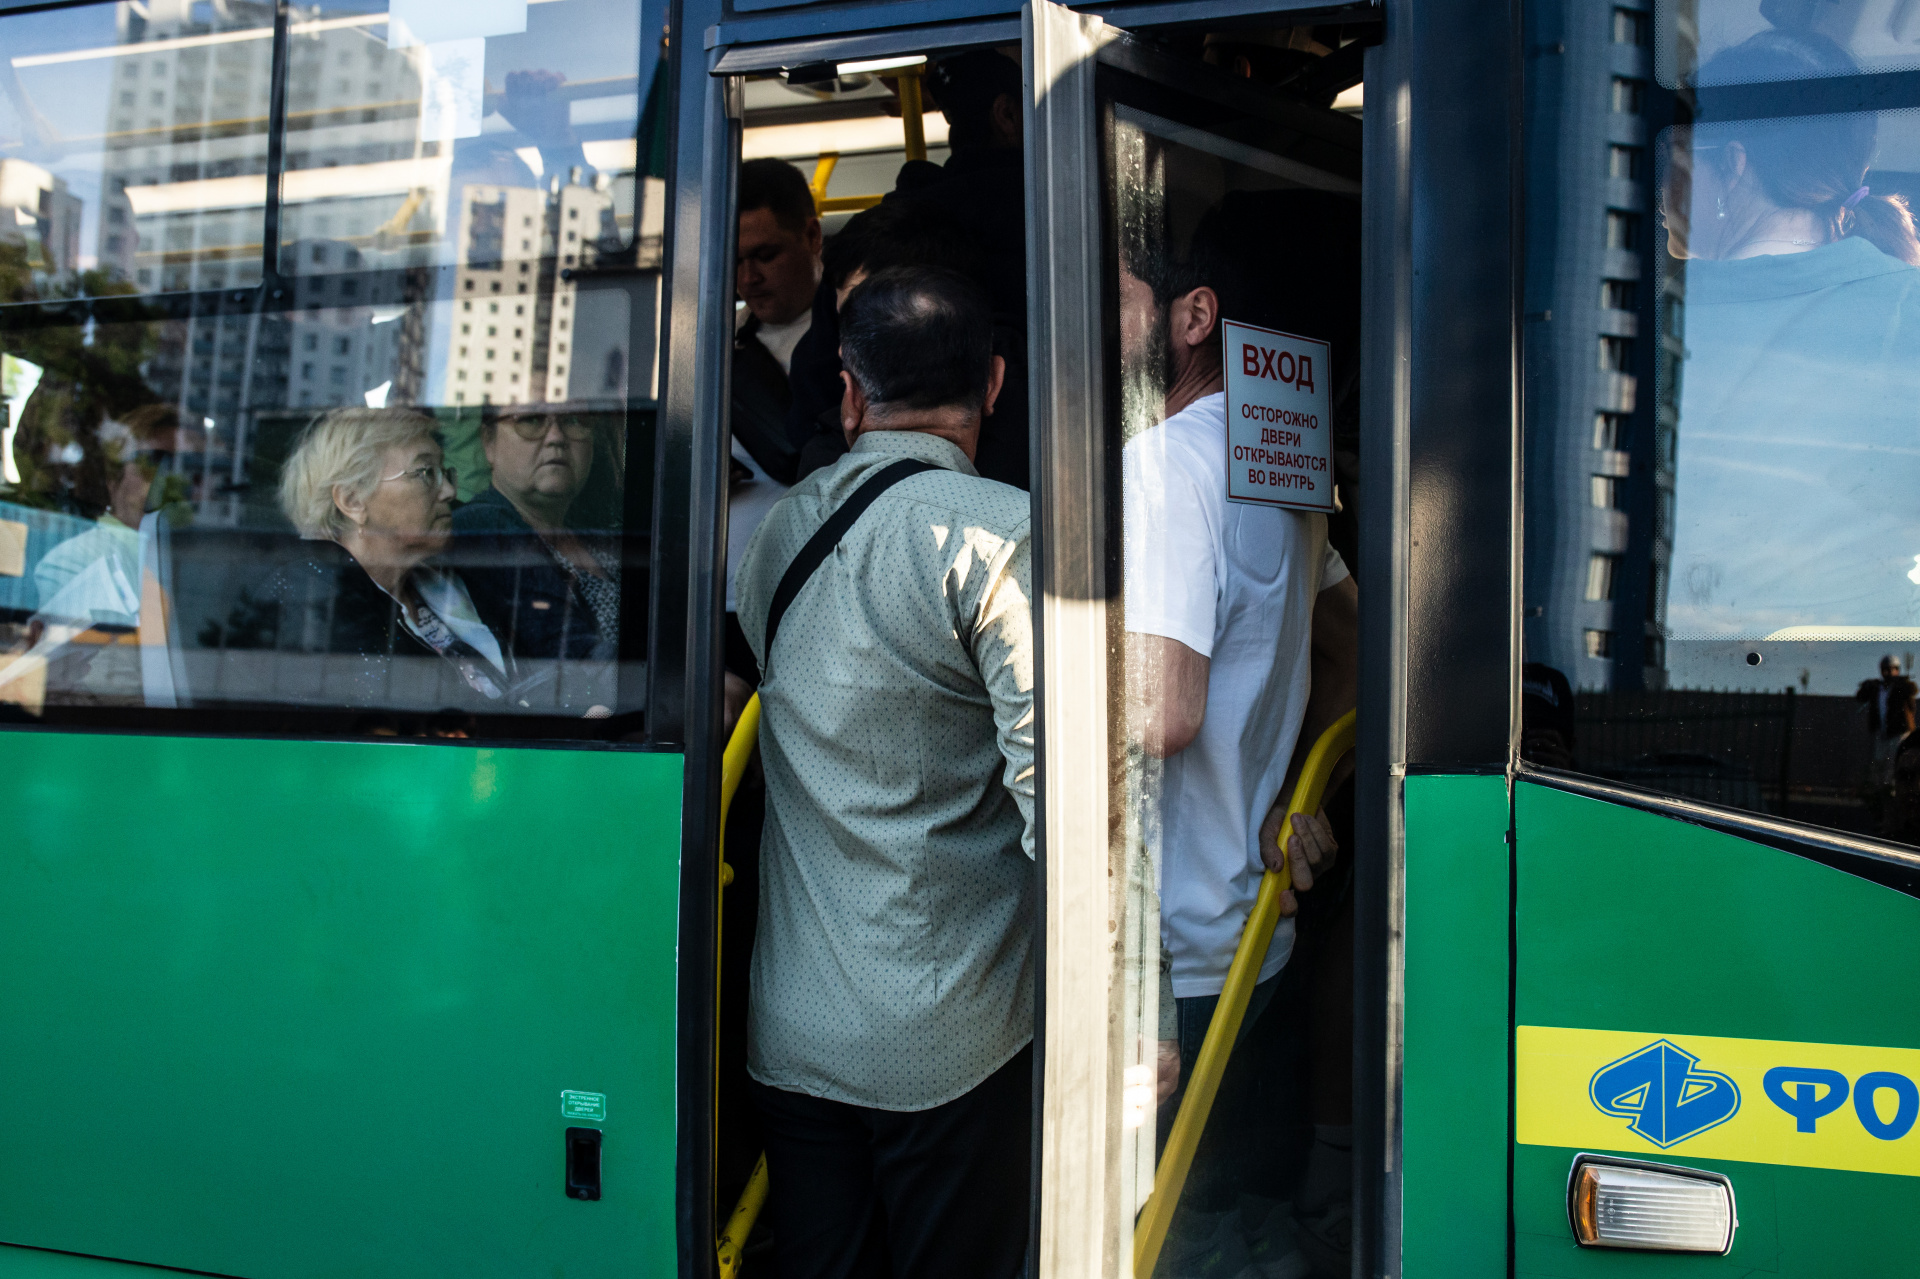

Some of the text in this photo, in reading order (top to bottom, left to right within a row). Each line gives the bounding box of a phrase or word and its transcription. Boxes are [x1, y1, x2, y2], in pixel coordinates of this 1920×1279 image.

[1242, 343, 1314, 394] ВХОД
[1241, 403, 1318, 429] ОСТОРОЖНО
[1261, 428, 1301, 448] ДВЕРИ
[1234, 445, 1327, 472] ОТКРЫВАЮТСЯ
[1248, 468, 1315, 491] ВО ВНУТРЬ
[568, 1094, 600, 1102] ЭКСТРЕННОЕ
